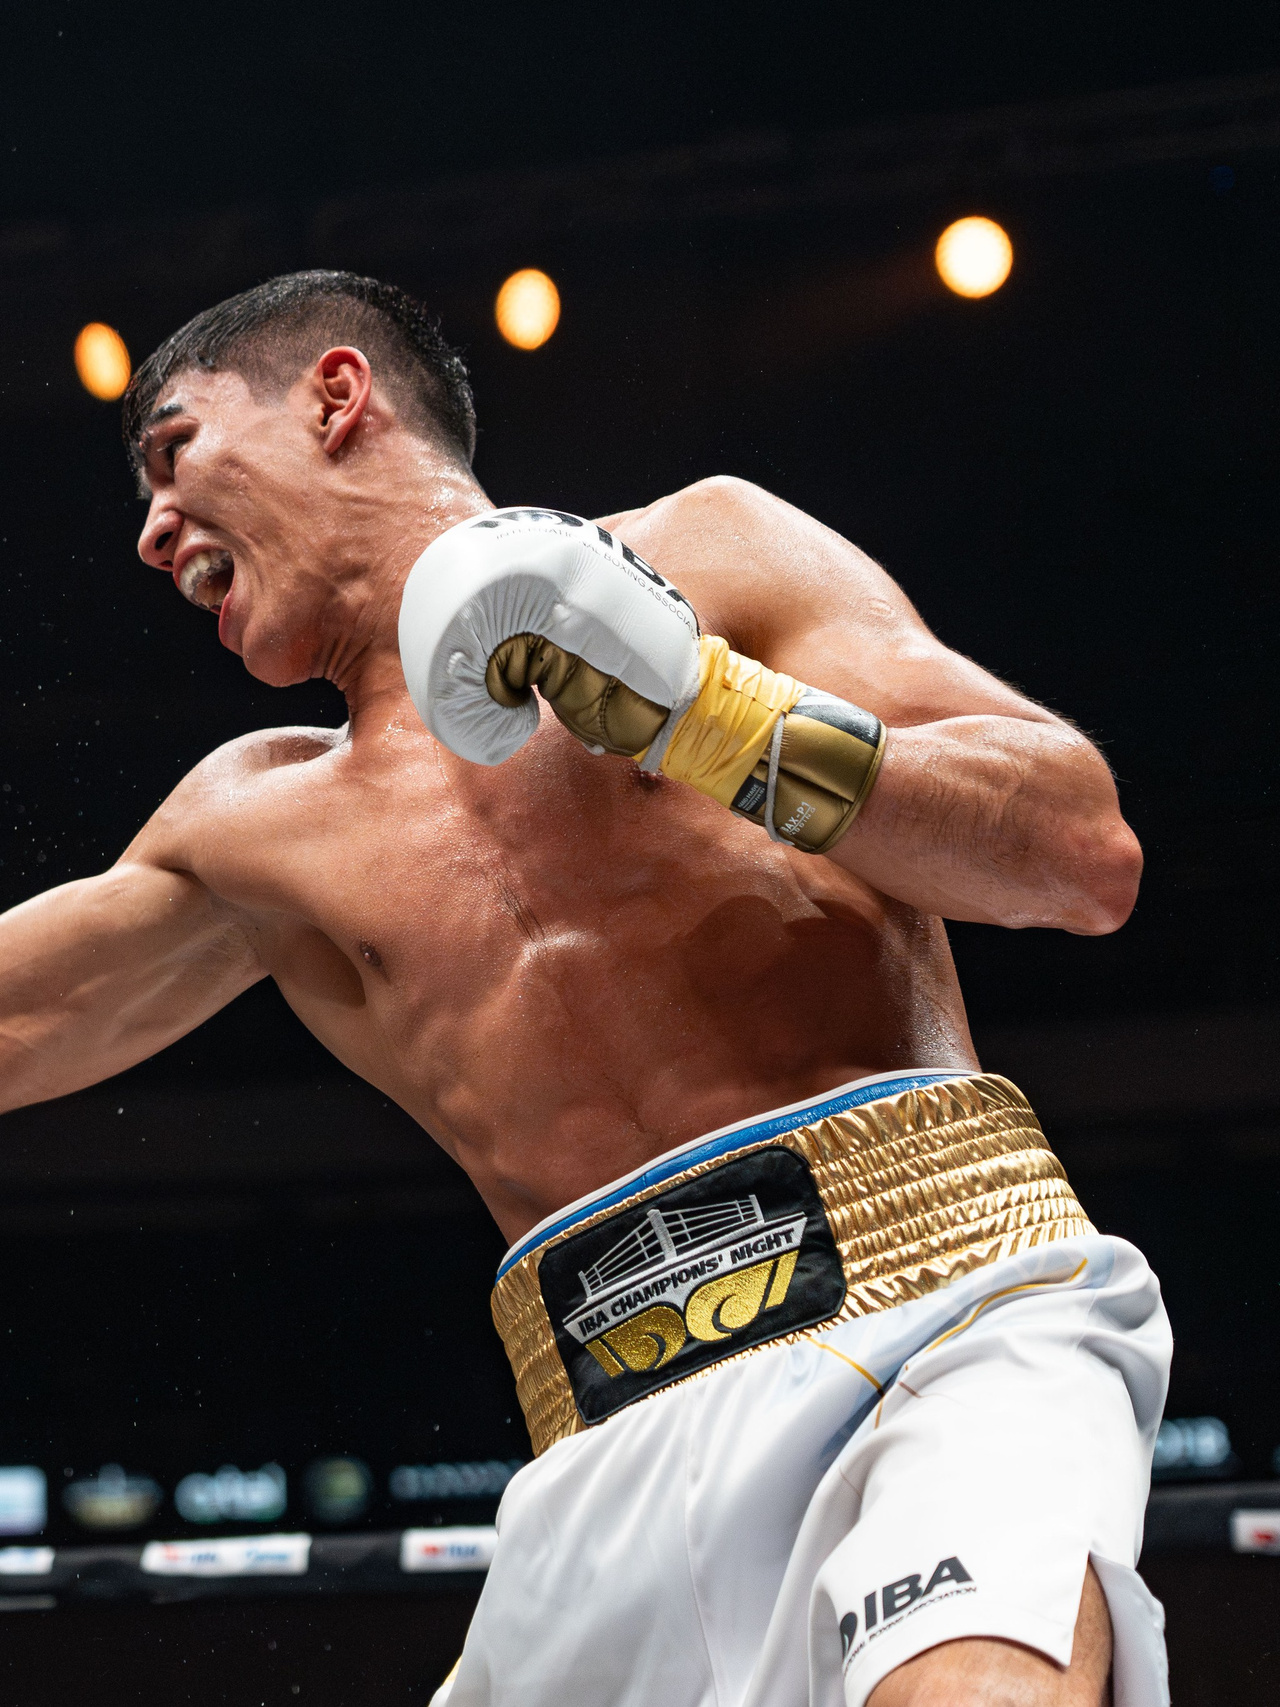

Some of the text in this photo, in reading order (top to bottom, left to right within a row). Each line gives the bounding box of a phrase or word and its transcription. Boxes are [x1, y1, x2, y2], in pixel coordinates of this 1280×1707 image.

[603, 552, 646, 588] BOXING
[578, 1228, 795, 1337] IBA CHAMPIONS' NIGHT
[864, 1556, 974, 1632] IBA
